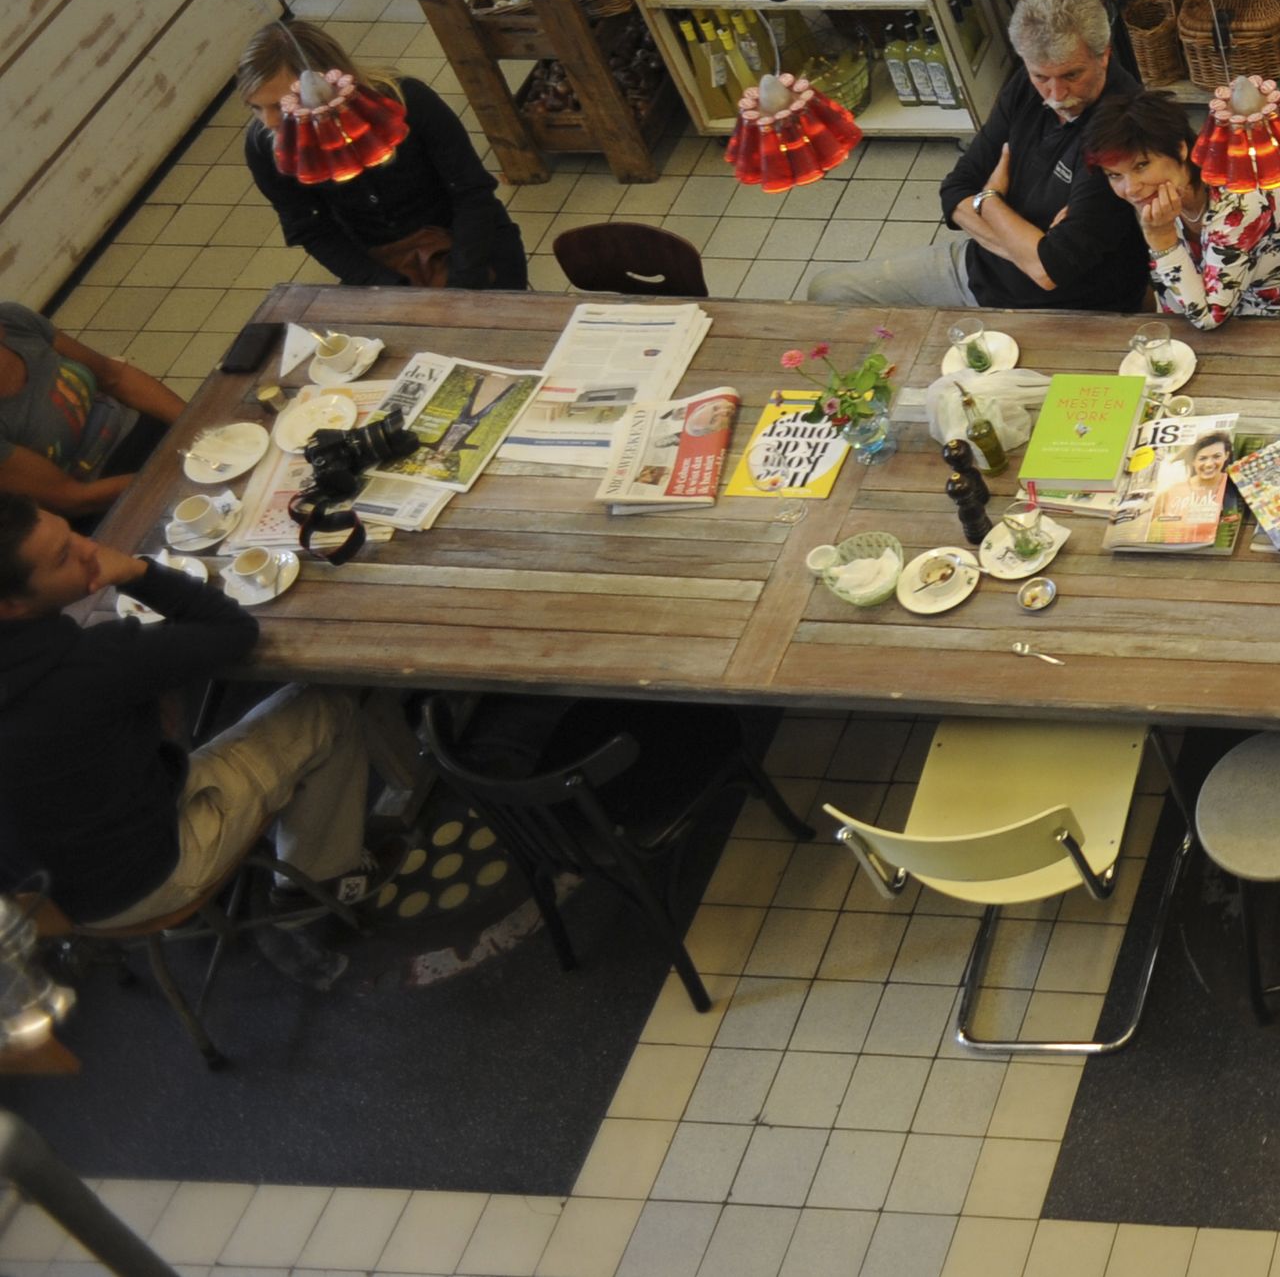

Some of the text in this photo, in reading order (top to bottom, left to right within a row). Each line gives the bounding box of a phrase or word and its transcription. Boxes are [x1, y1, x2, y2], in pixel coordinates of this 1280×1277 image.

[1079, 386, 1112, 398] MET
[1056, 398, 1125, 410] MEST EN
[1066, 410, 1110, 422] VORK
